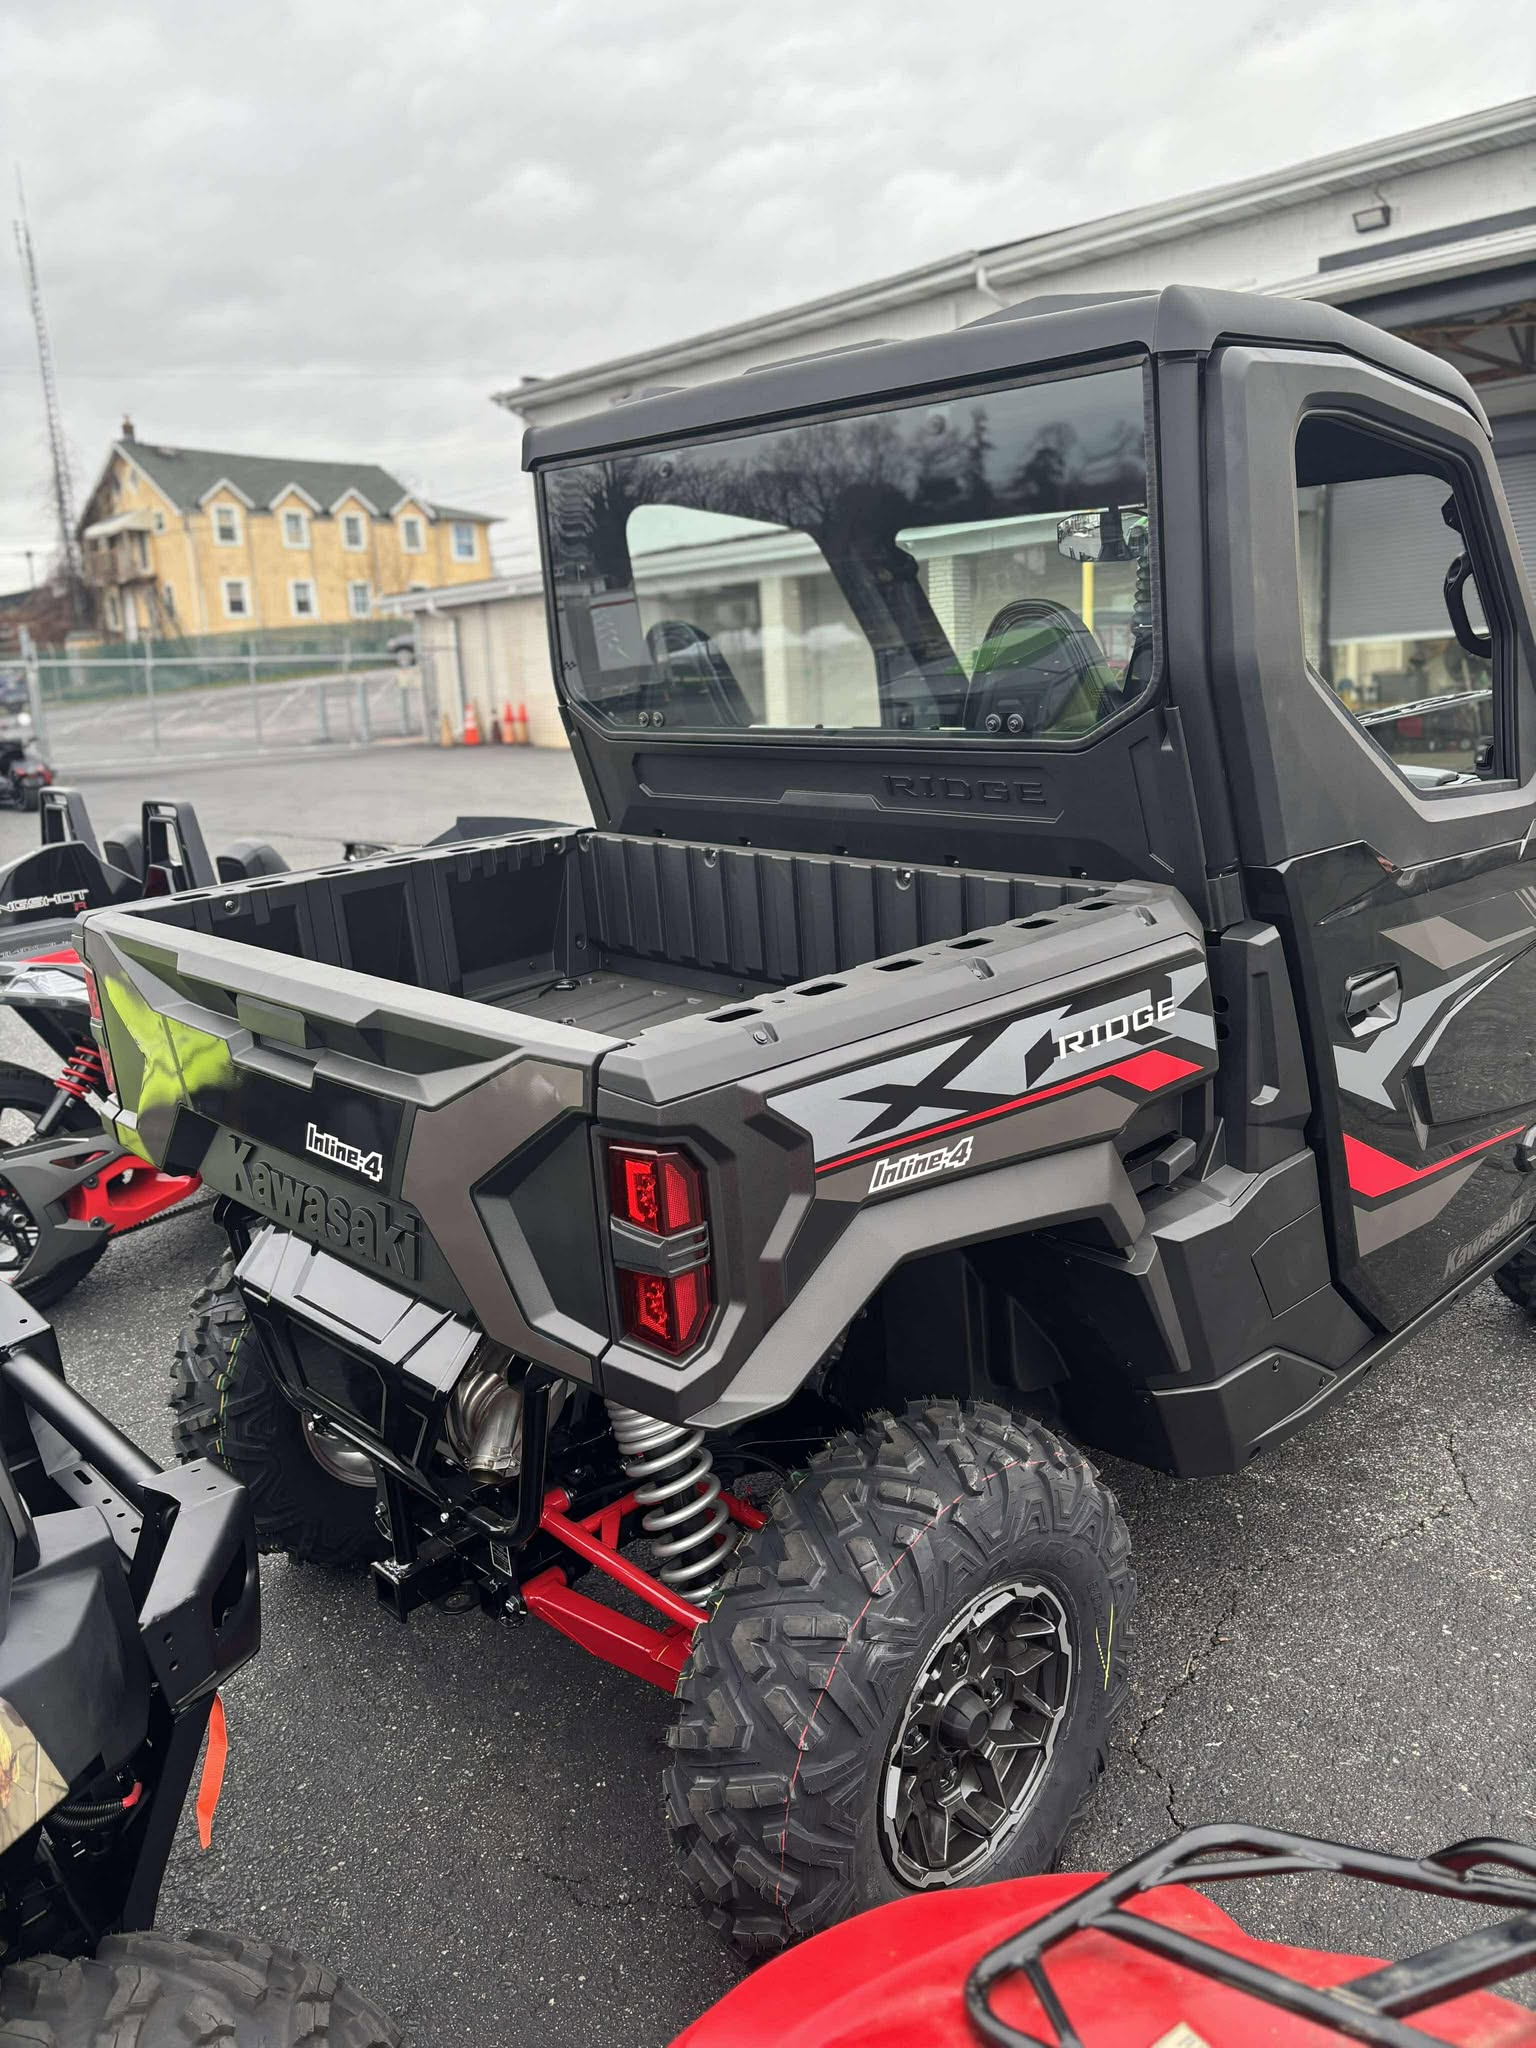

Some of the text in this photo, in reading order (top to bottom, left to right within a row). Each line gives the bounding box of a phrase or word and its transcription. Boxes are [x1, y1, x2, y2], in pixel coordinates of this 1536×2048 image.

[882, 775, 1046, 806] RIDGE
[1058, 996, 1177, 1060] RIDGE
[305, 1122, 383, 1182] Inline-4
[868, 1136, 975, 1194] Inline-4
[228, 1134, 421, 1281] Kawasaki
[1443, 1196, 1525, 1281] Kawasaki
